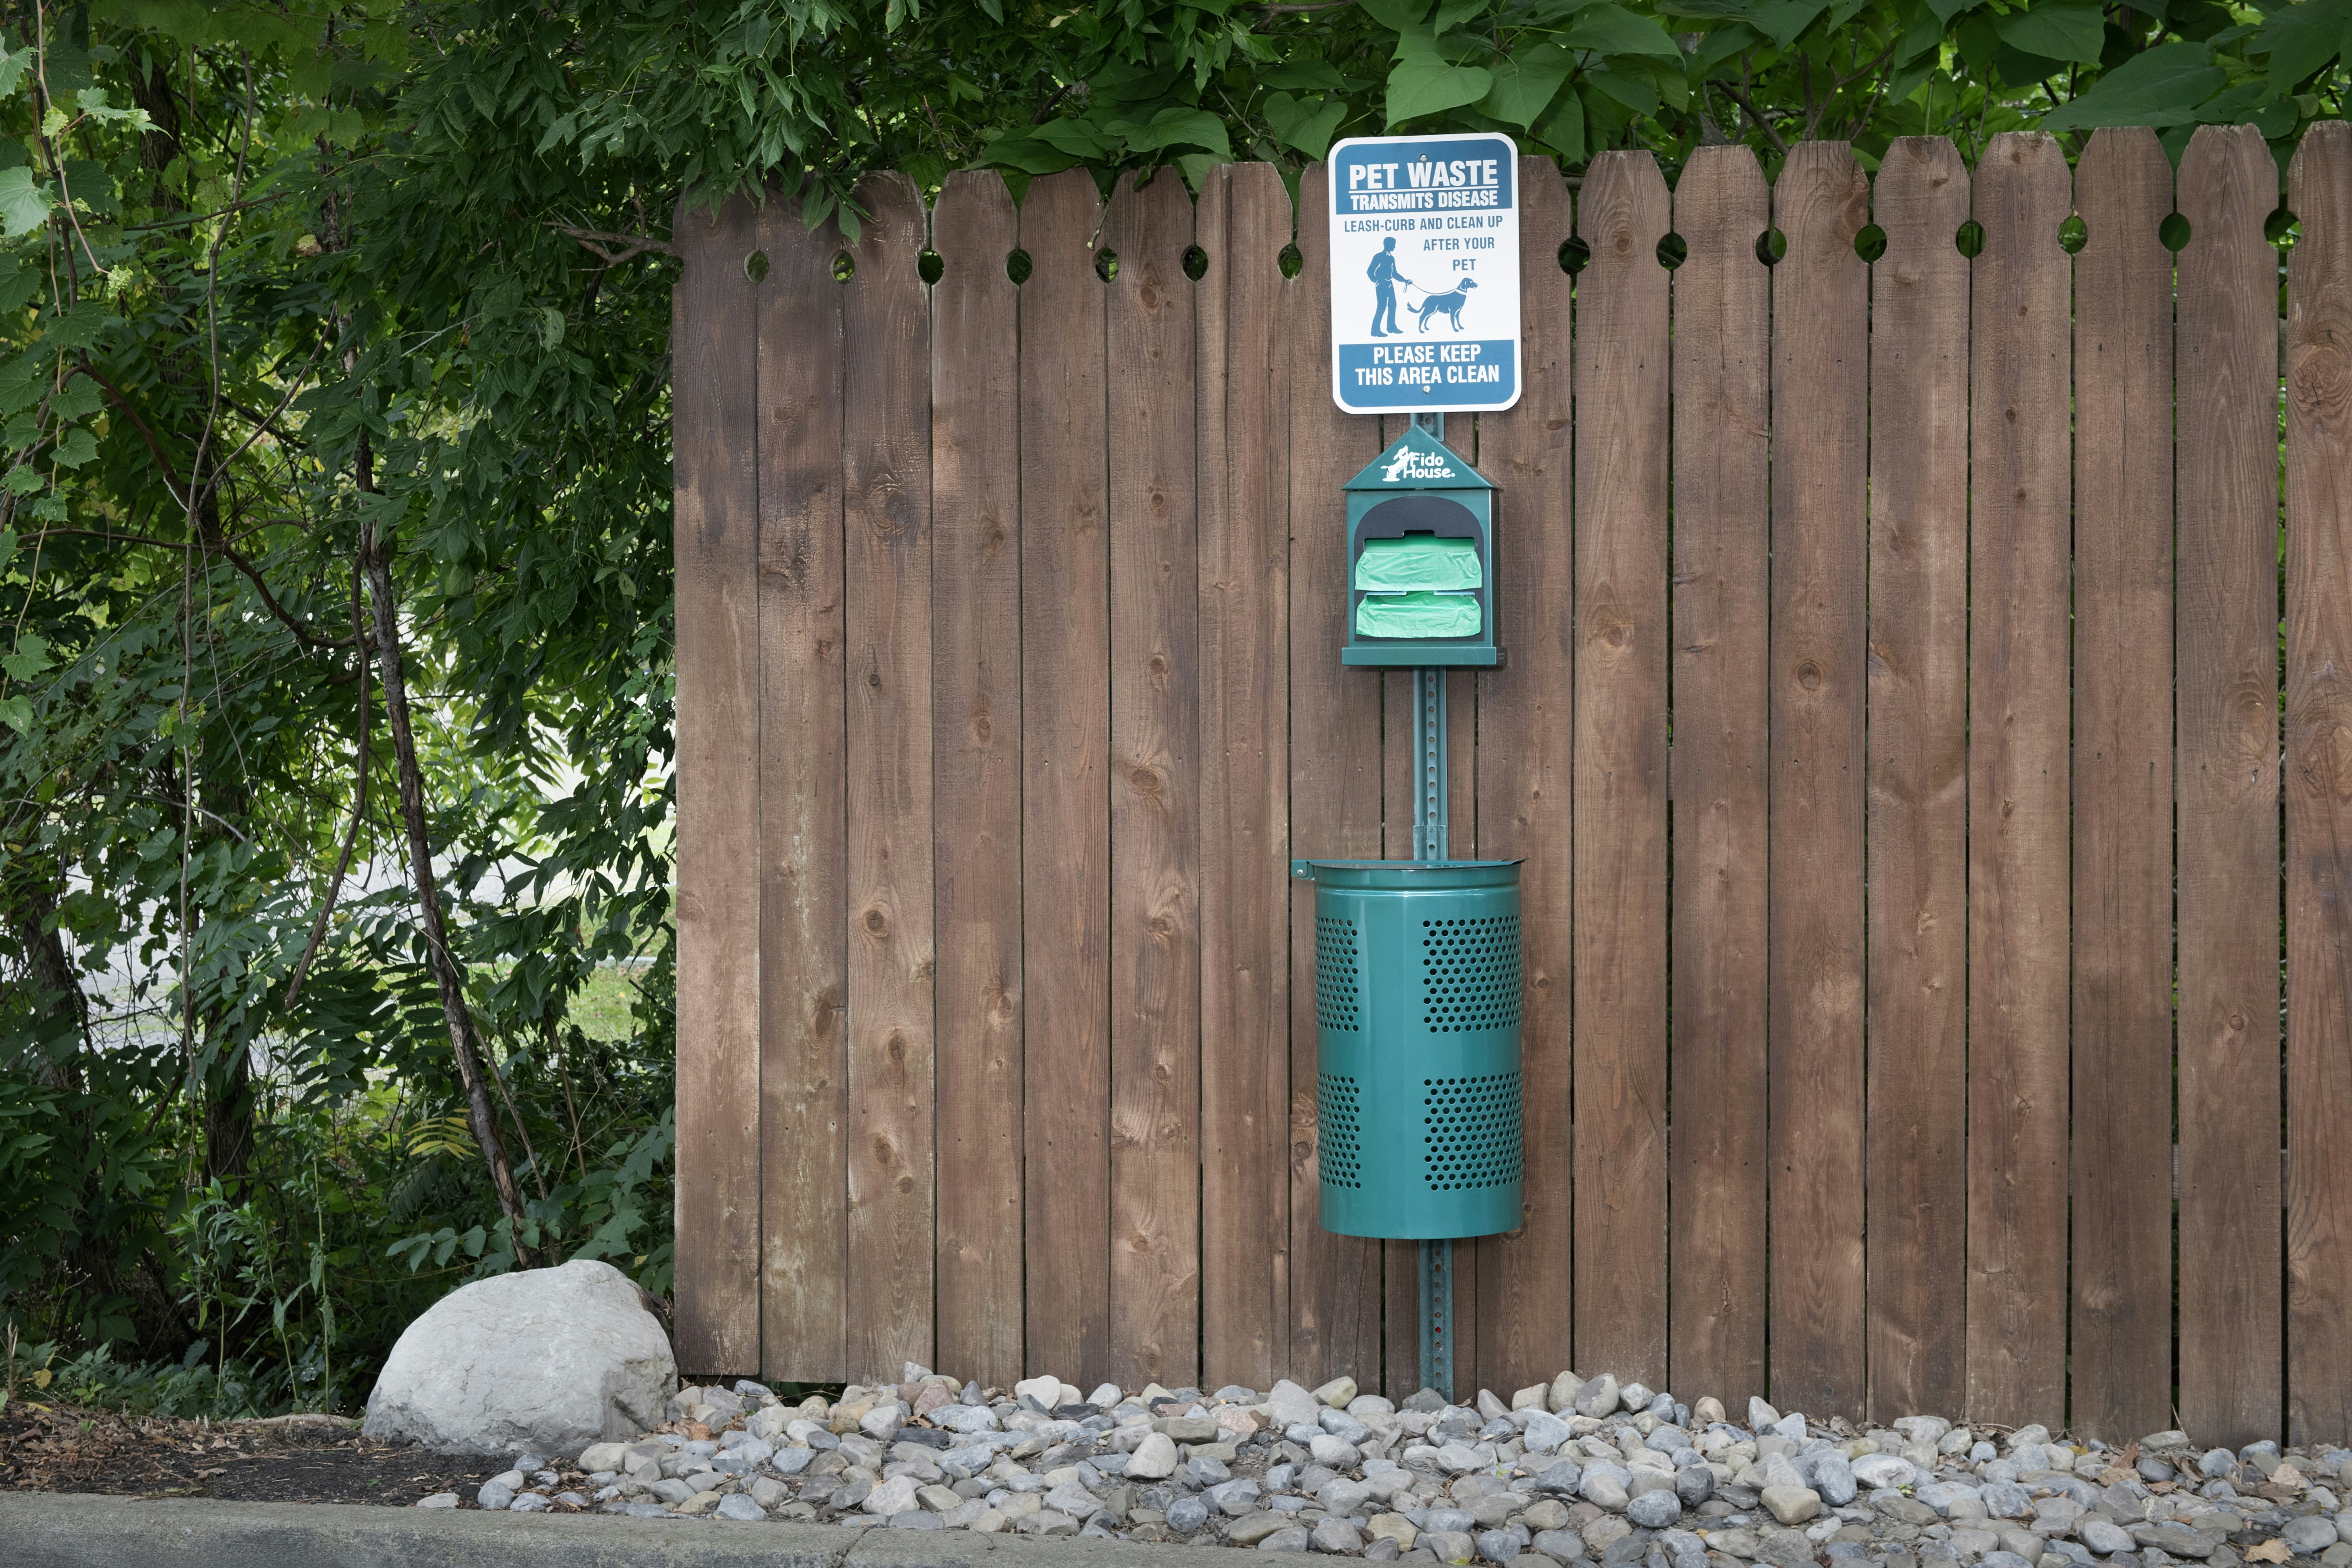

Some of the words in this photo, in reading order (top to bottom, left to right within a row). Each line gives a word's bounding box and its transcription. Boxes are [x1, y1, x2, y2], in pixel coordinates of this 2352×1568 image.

[1348, 163, 1399, 190] PET
[1407, 159, 1498, 188] WASTE
[1351, 192, 1434, 210] TRANSMITS
[1438, 190, 1498, 208] DISEASE
[1344, 219, 1415, 232] LEASH-CURB
[1420, 218, 1443, 229] AND
[1447, 217, 1483, 229] CLEAN
[1487, 215, 1503, 227] UP
[1423, 238, 1460, 251] AFTER
[1464, 237, 1495, 249] YOUR
[1453, 259, 1476, 271] PET
[1374, 346, 1434, 364] PLEASE
[1440, 344, 1481, 362] KEEP
[1355, 368, 1393, 386] THIS
[1398, 367, 1442, 384] AREA
[1447, 365, 1499, 383] CLEAN
[1410, 452, 1444, 467] Fido
